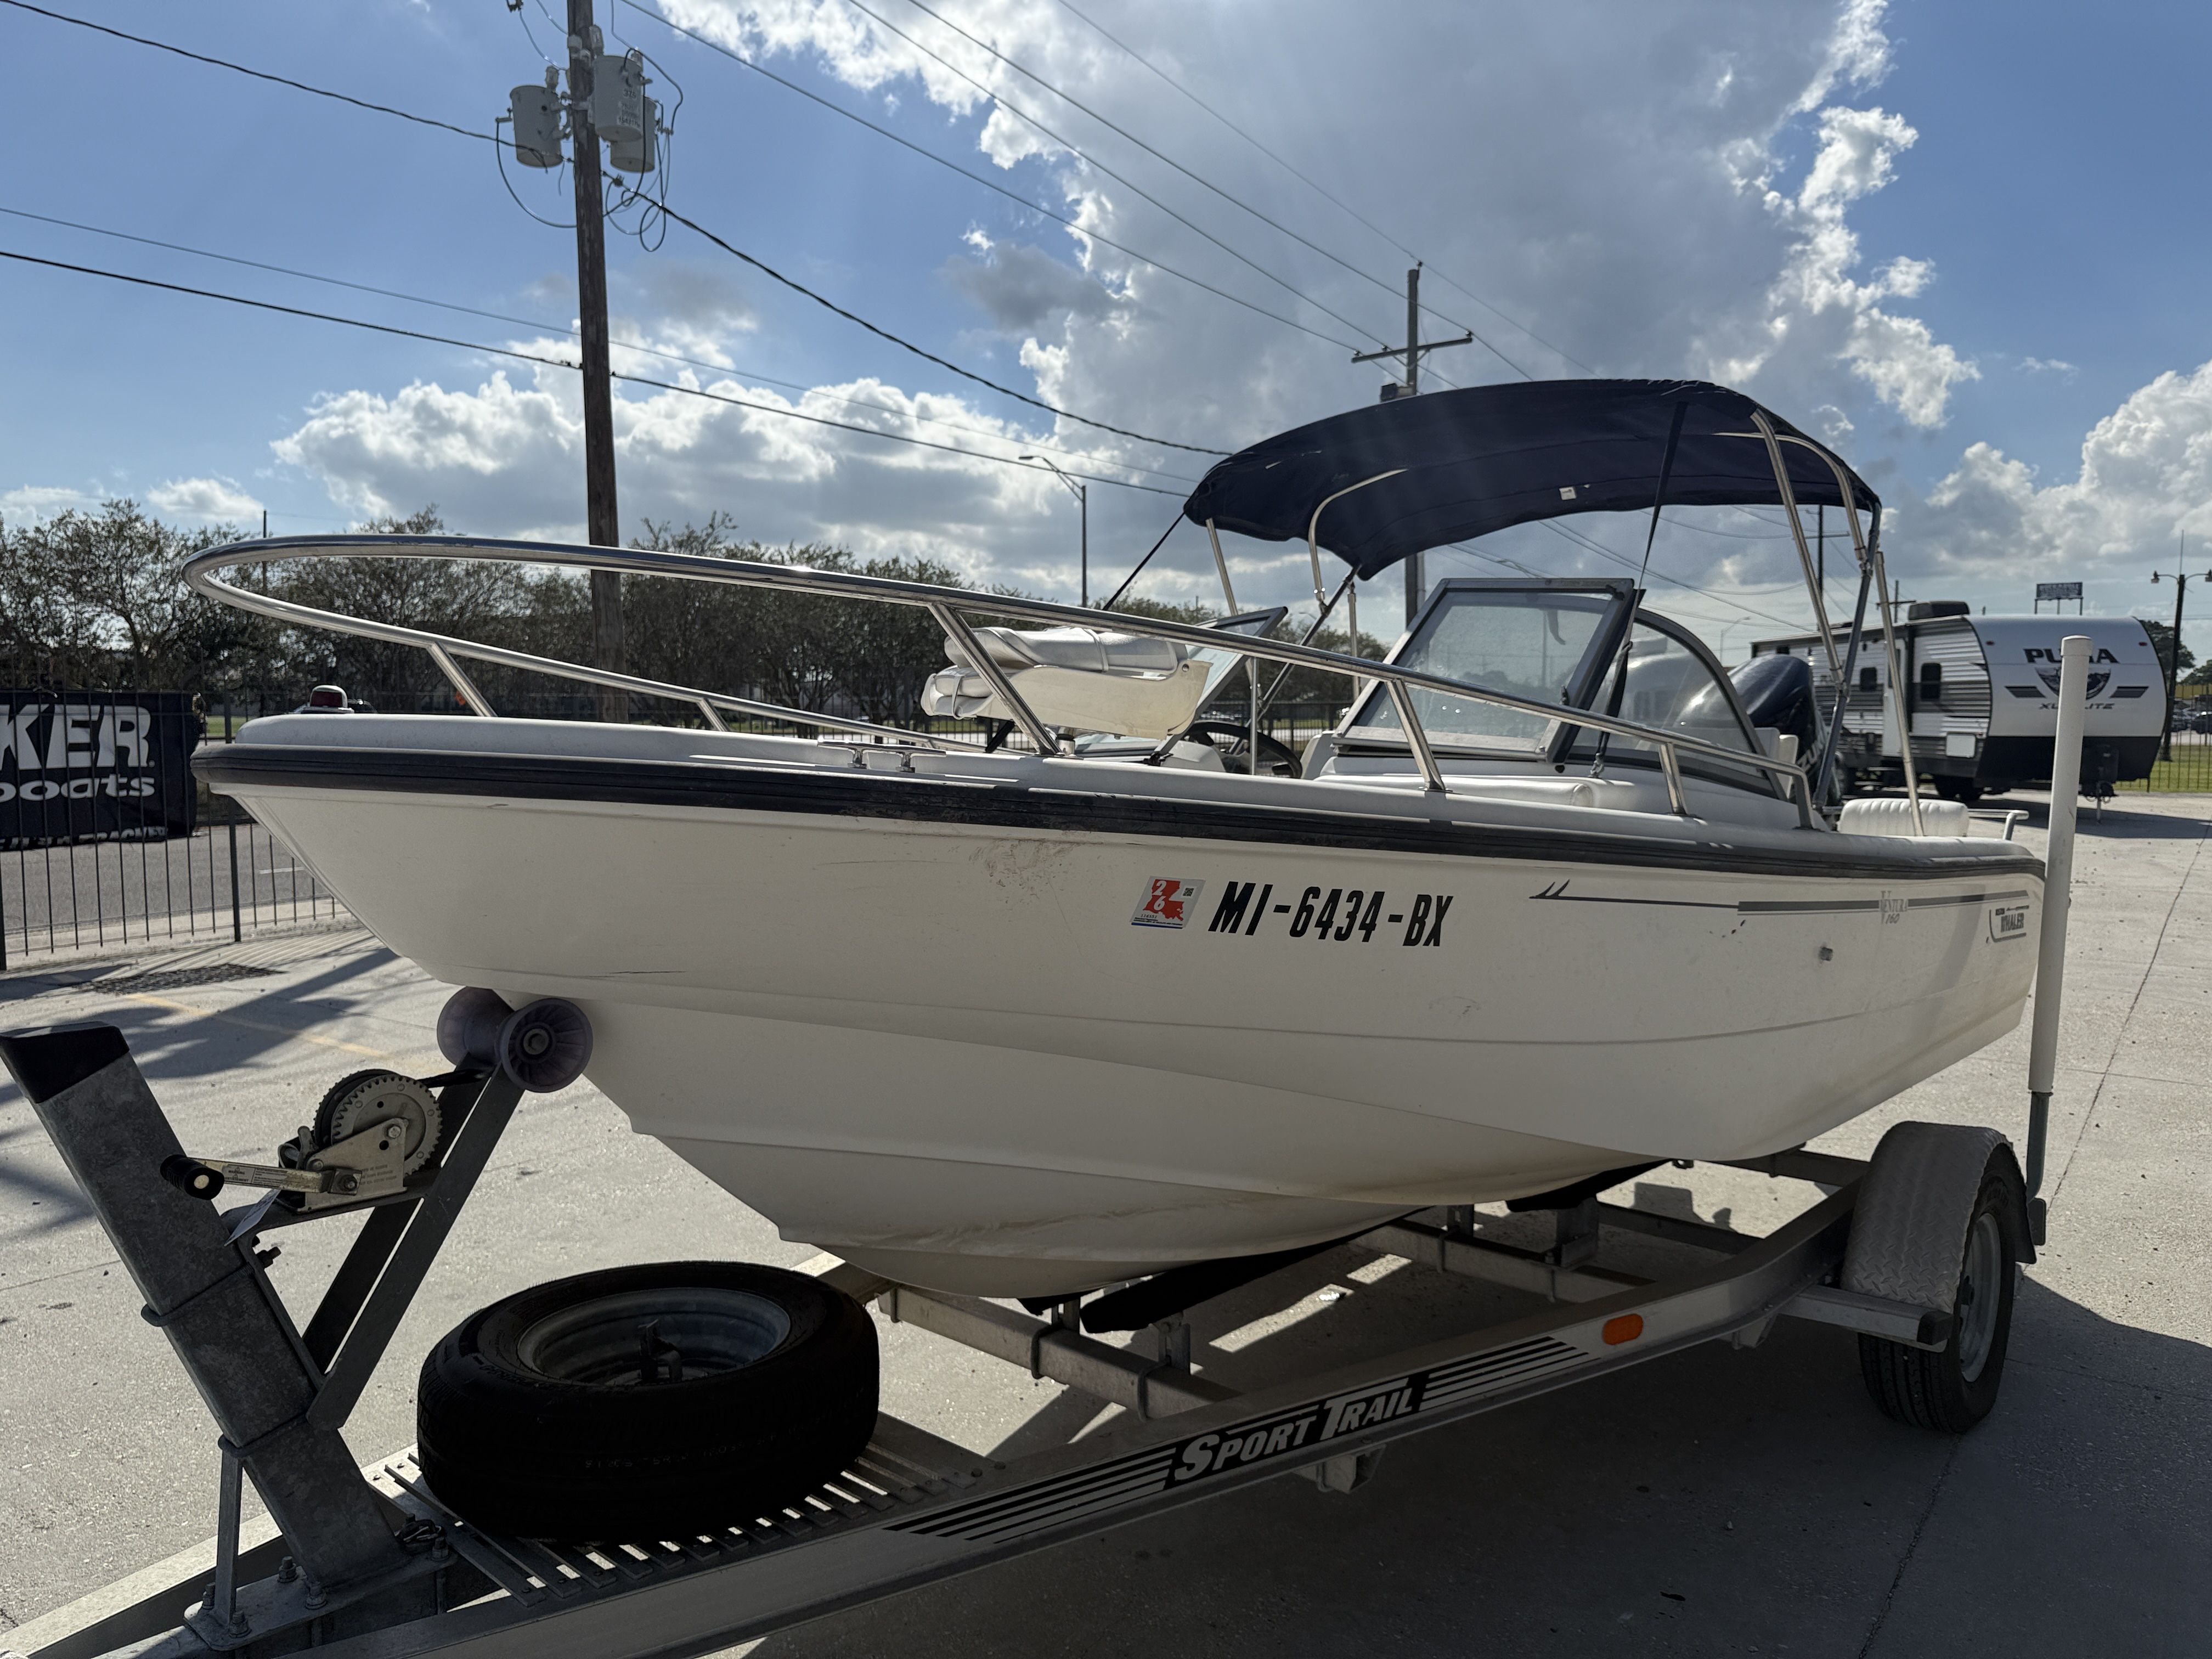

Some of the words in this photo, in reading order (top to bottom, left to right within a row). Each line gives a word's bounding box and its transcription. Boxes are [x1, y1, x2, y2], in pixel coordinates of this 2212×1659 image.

[2023, 648, 2120, 663] PUA
[2000, 912, 2024, 933] WHALER
[1175, 1415, 1317, 1481] SPORT
[1320, 1378, 1413, 1440] TRAIL
